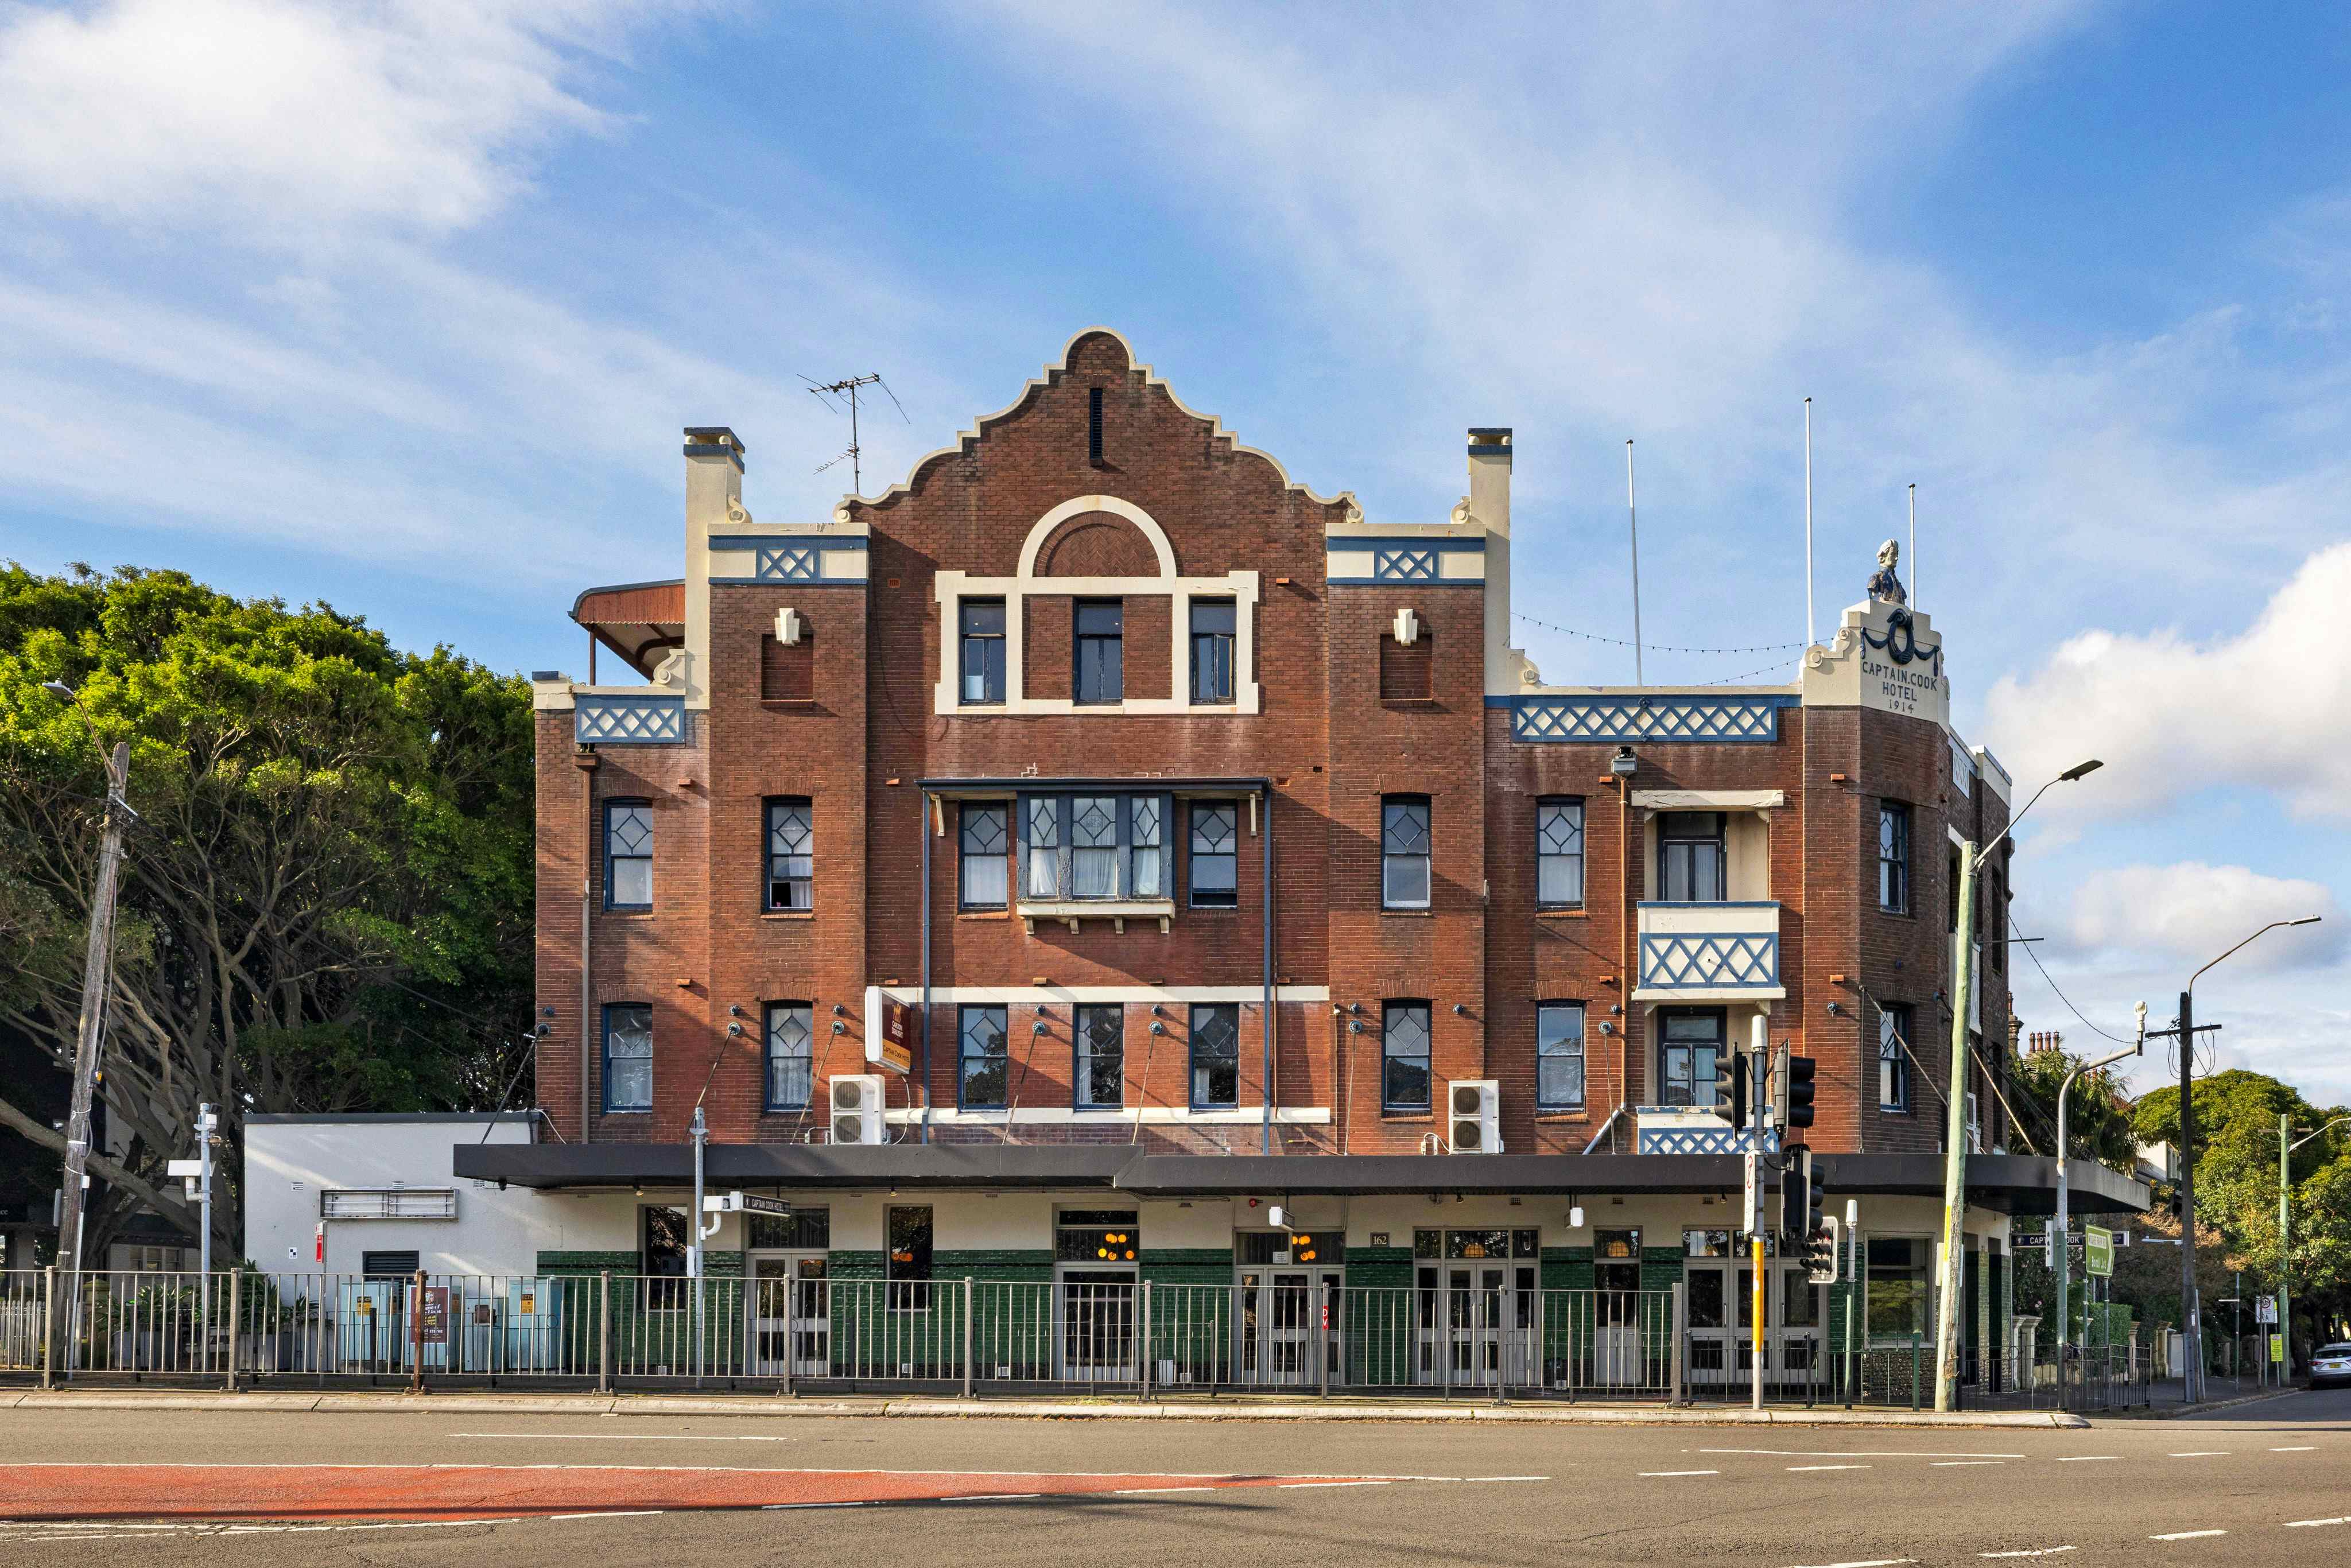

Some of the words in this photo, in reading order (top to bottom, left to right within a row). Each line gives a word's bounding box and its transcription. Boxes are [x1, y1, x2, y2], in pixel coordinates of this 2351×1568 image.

[1883, 681, 1918, 702] HOTEL
[1889, 699, 1914, 713] 1914
[752, 1198, 765, 1209] CAPTAIN
[765, 1201, 774, 1210] COOK
[774, 1202, 784, 1212] HOTEL
[1373, 1235, 1387, 1245] 162
[2030, 1236, 2047, 1244] CAPT
